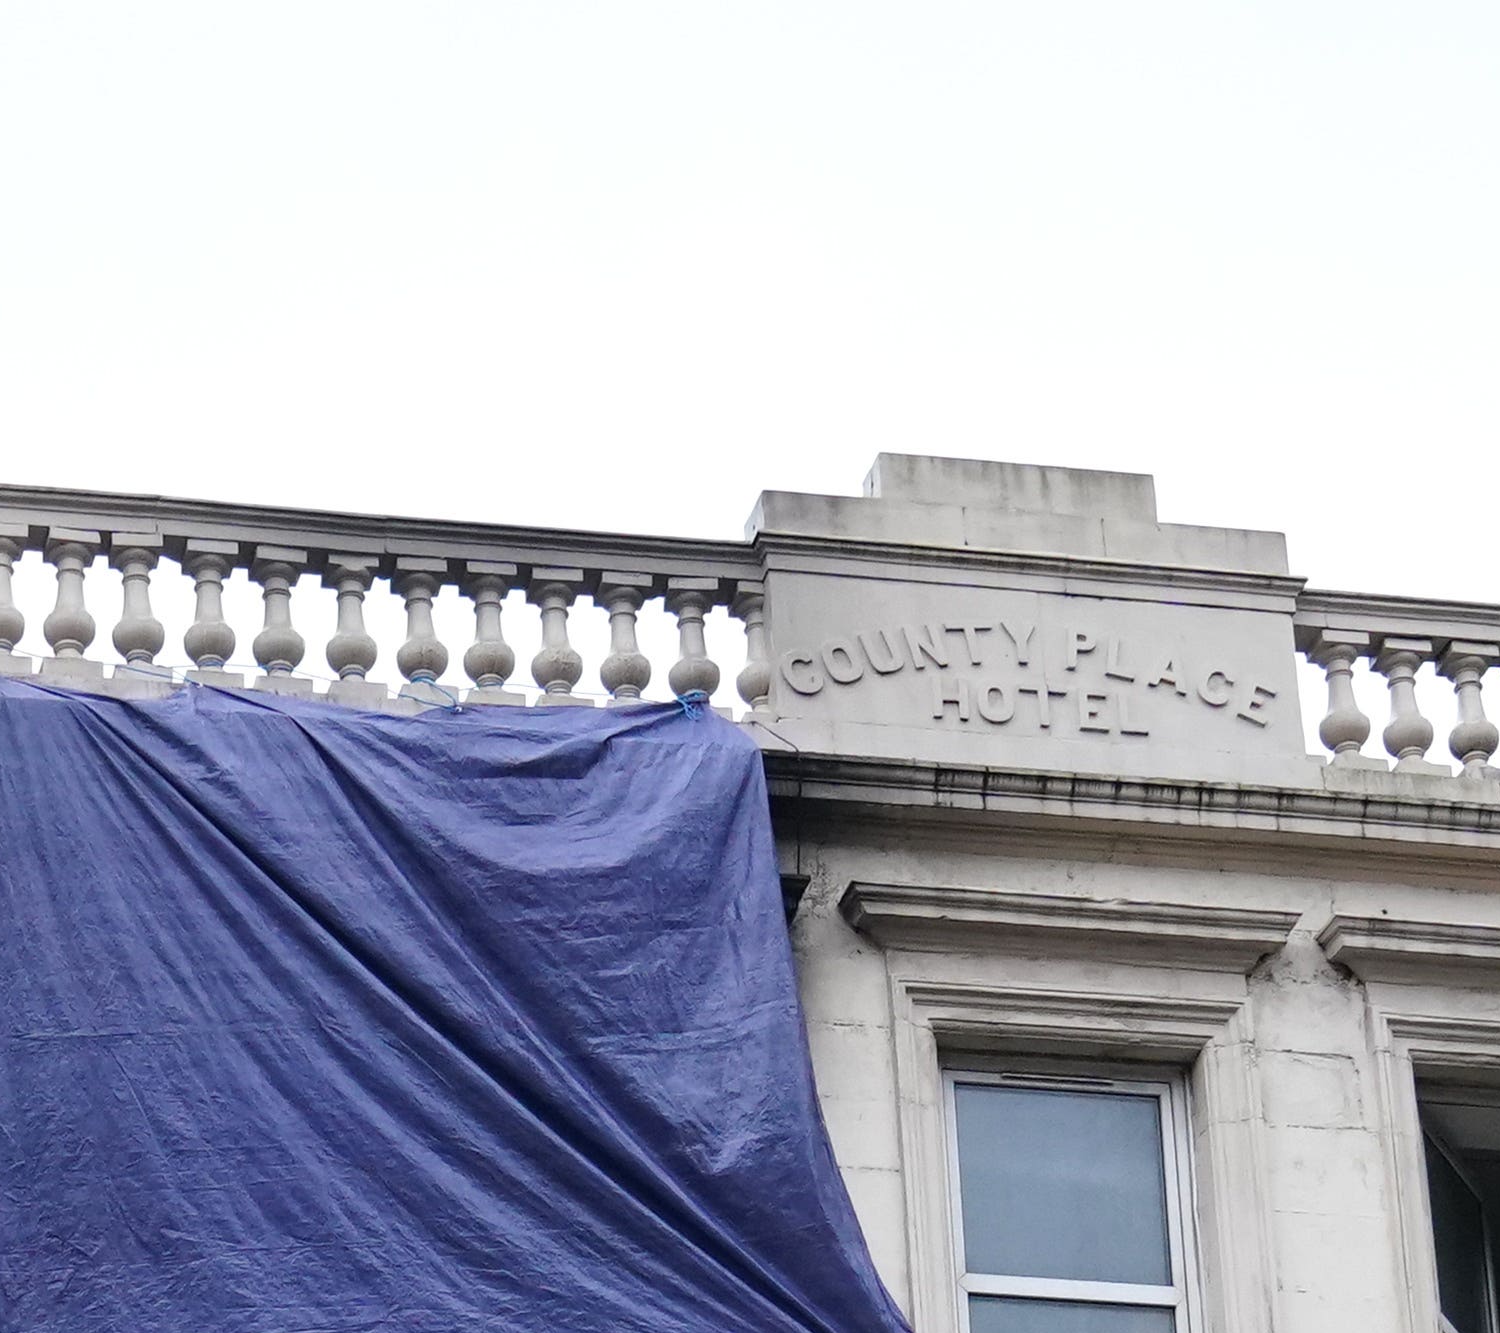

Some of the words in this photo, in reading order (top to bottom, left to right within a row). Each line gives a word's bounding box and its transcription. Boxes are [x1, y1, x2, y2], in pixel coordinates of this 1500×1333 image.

[781, 620, 1041, 696] COUNTY
[1066, 626, 1281, 729] PLACE
[931, 675, 1151, 738] HOTEL
